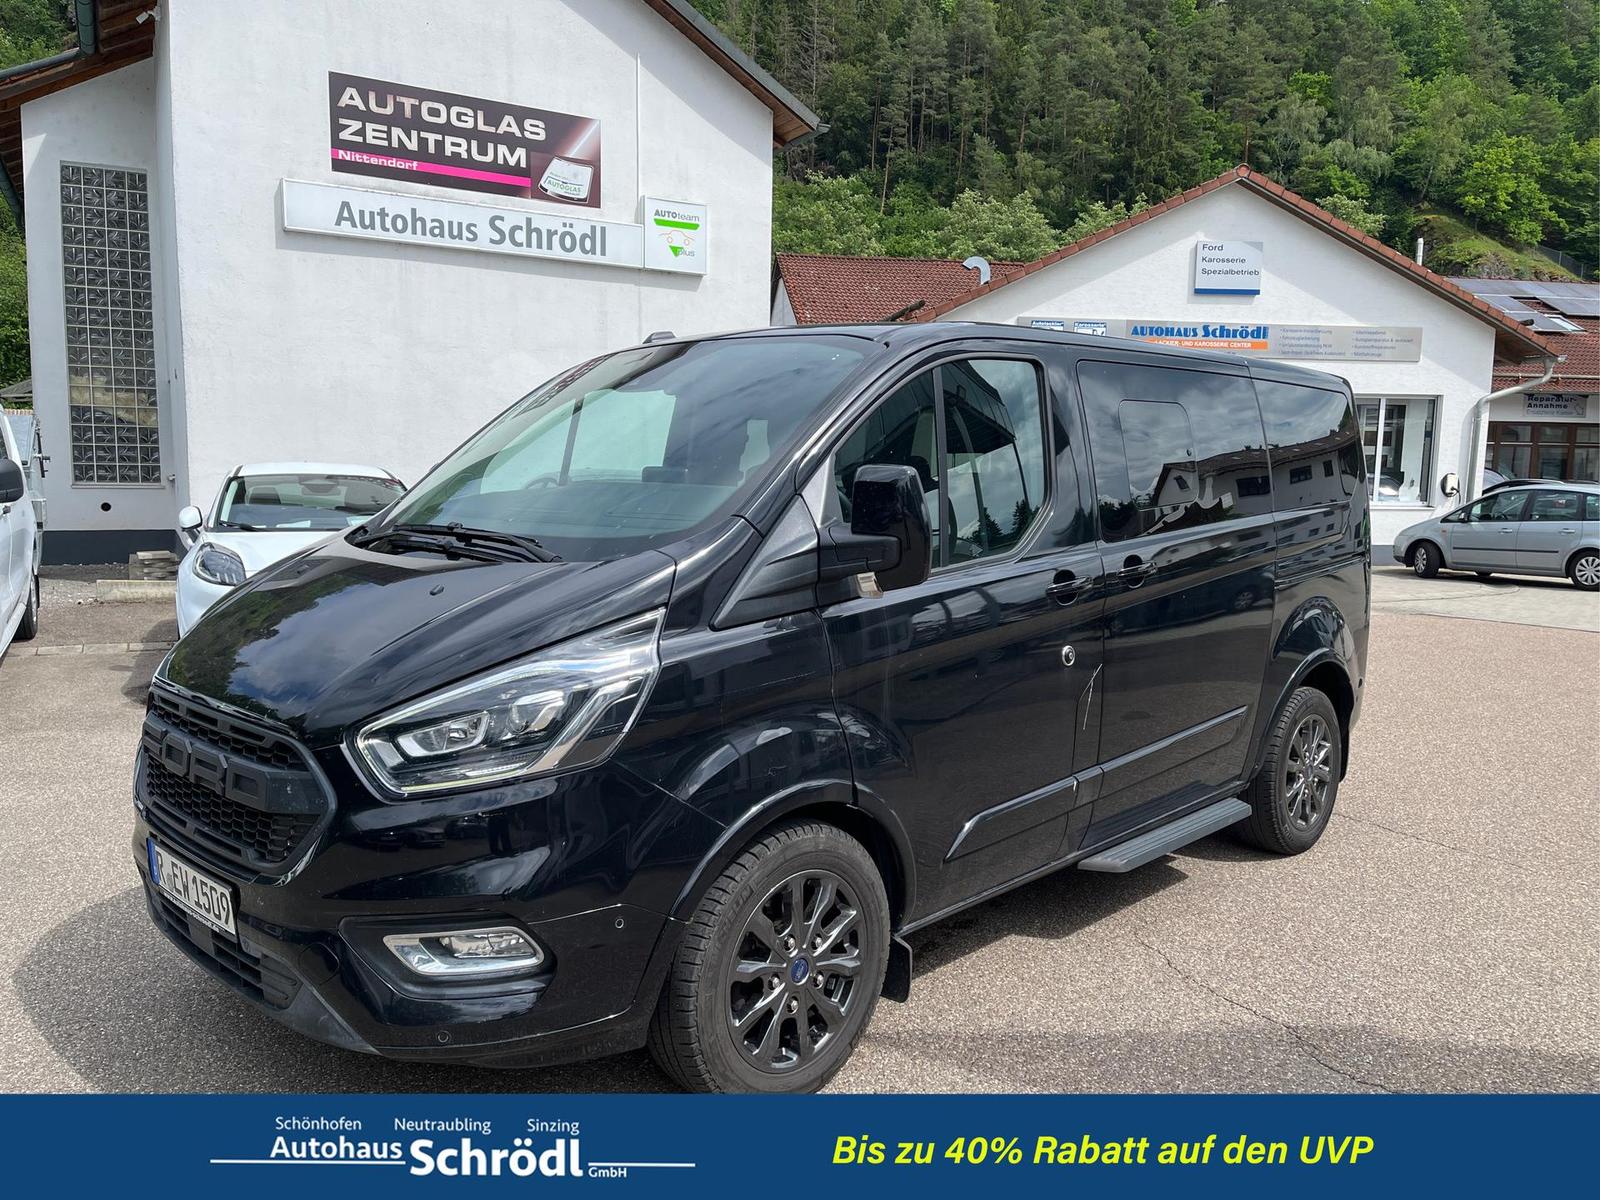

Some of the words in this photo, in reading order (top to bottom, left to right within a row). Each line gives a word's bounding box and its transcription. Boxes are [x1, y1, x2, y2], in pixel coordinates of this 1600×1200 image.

[337, 86, 546, 141] AUTOGLAS
[338, 117, 527, 168] ZENTRUM
[338, 149, 418, 170] Nittendorf
[654, 208, 700, 221] AUTOteam
[334, 200, 478, 242] Autohaus
[488, 214, 607, 257] Schrödl
[1202, 243, 1224, 251] Ford
[1201, 267, 1260, 276] Spezialbetrieb
[1131, 325, 1198, 337] AUTOHAUS
[1201, 325, 1268, 339] Schrödl
[156, 849, 167, 886] R
[192, 874, 231, 926] 1509
